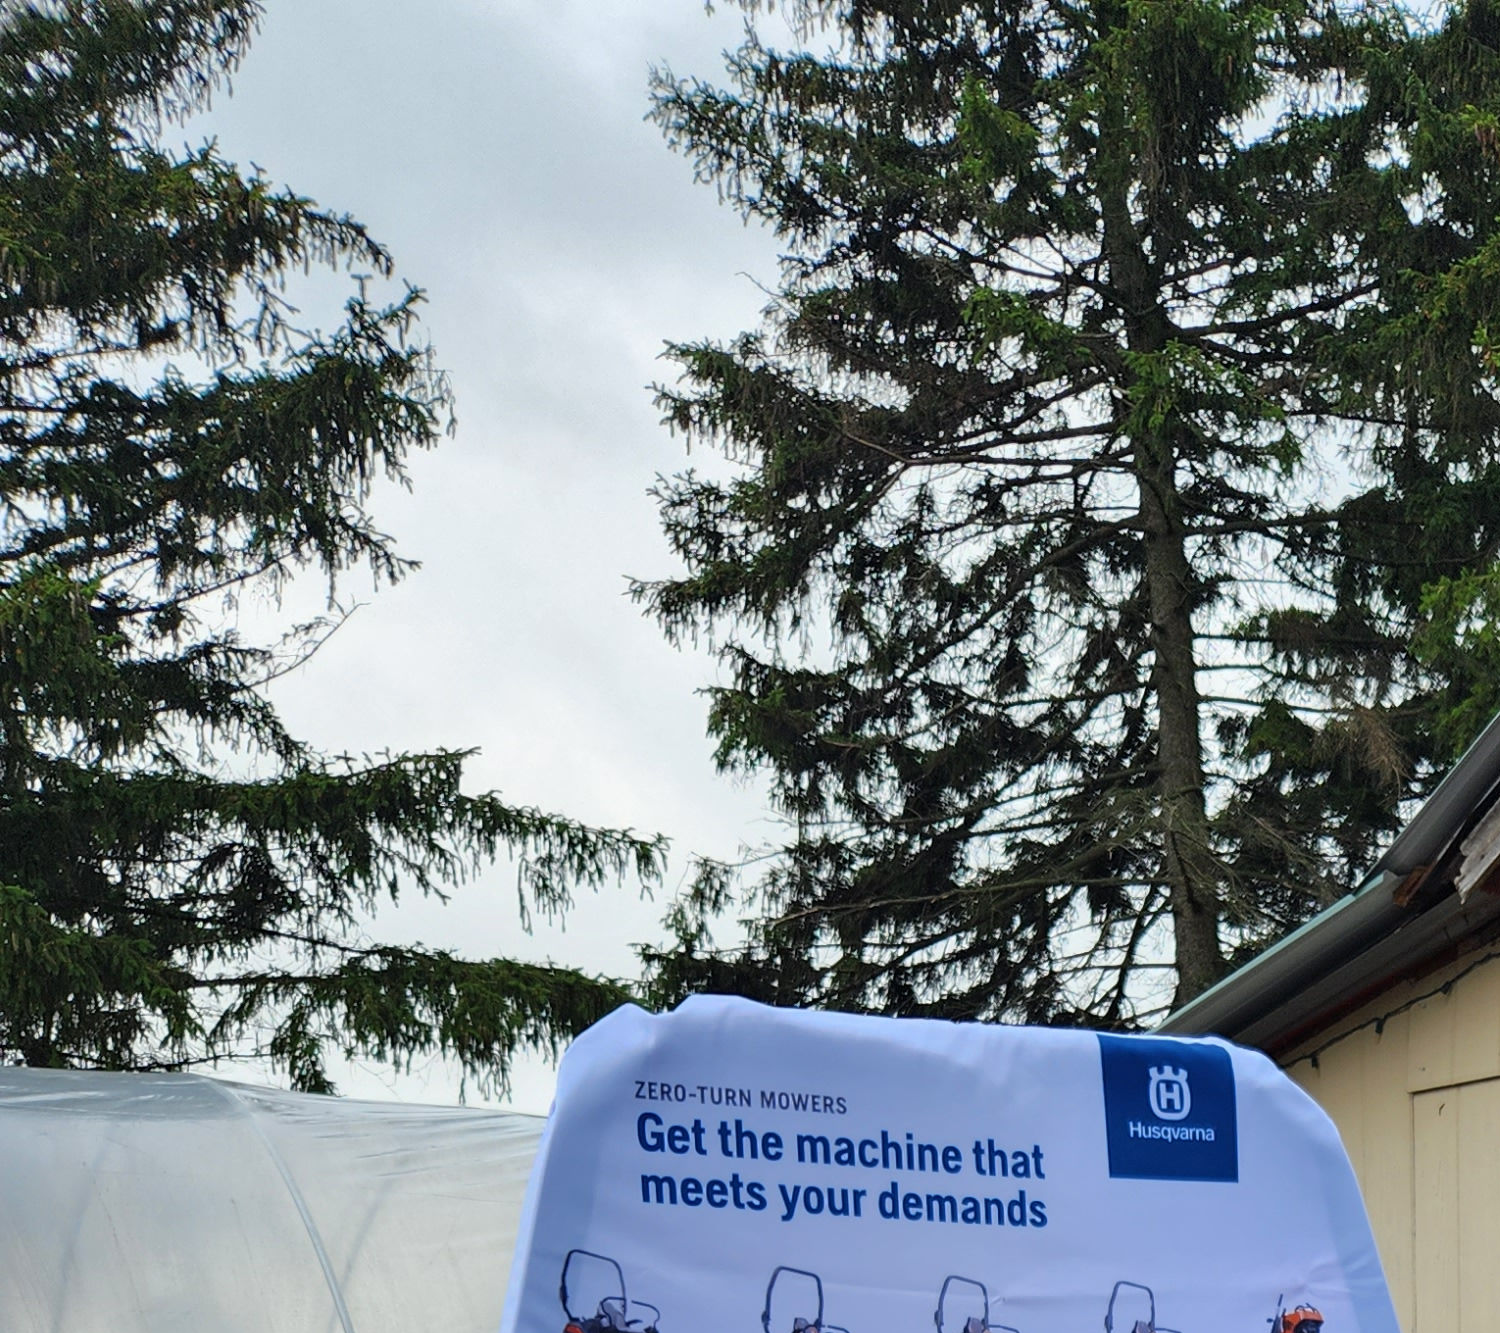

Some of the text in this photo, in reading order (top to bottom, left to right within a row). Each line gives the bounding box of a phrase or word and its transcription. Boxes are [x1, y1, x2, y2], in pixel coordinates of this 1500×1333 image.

[633, 1080, 849, 1116] ZERO-TURN MOWERS
[636, 1111, 1046, 1180] Get the machine that
[1128, 1120, 1216, 1144] Husqvarna
[639, 1170, 1049, 1228] meets your demands
